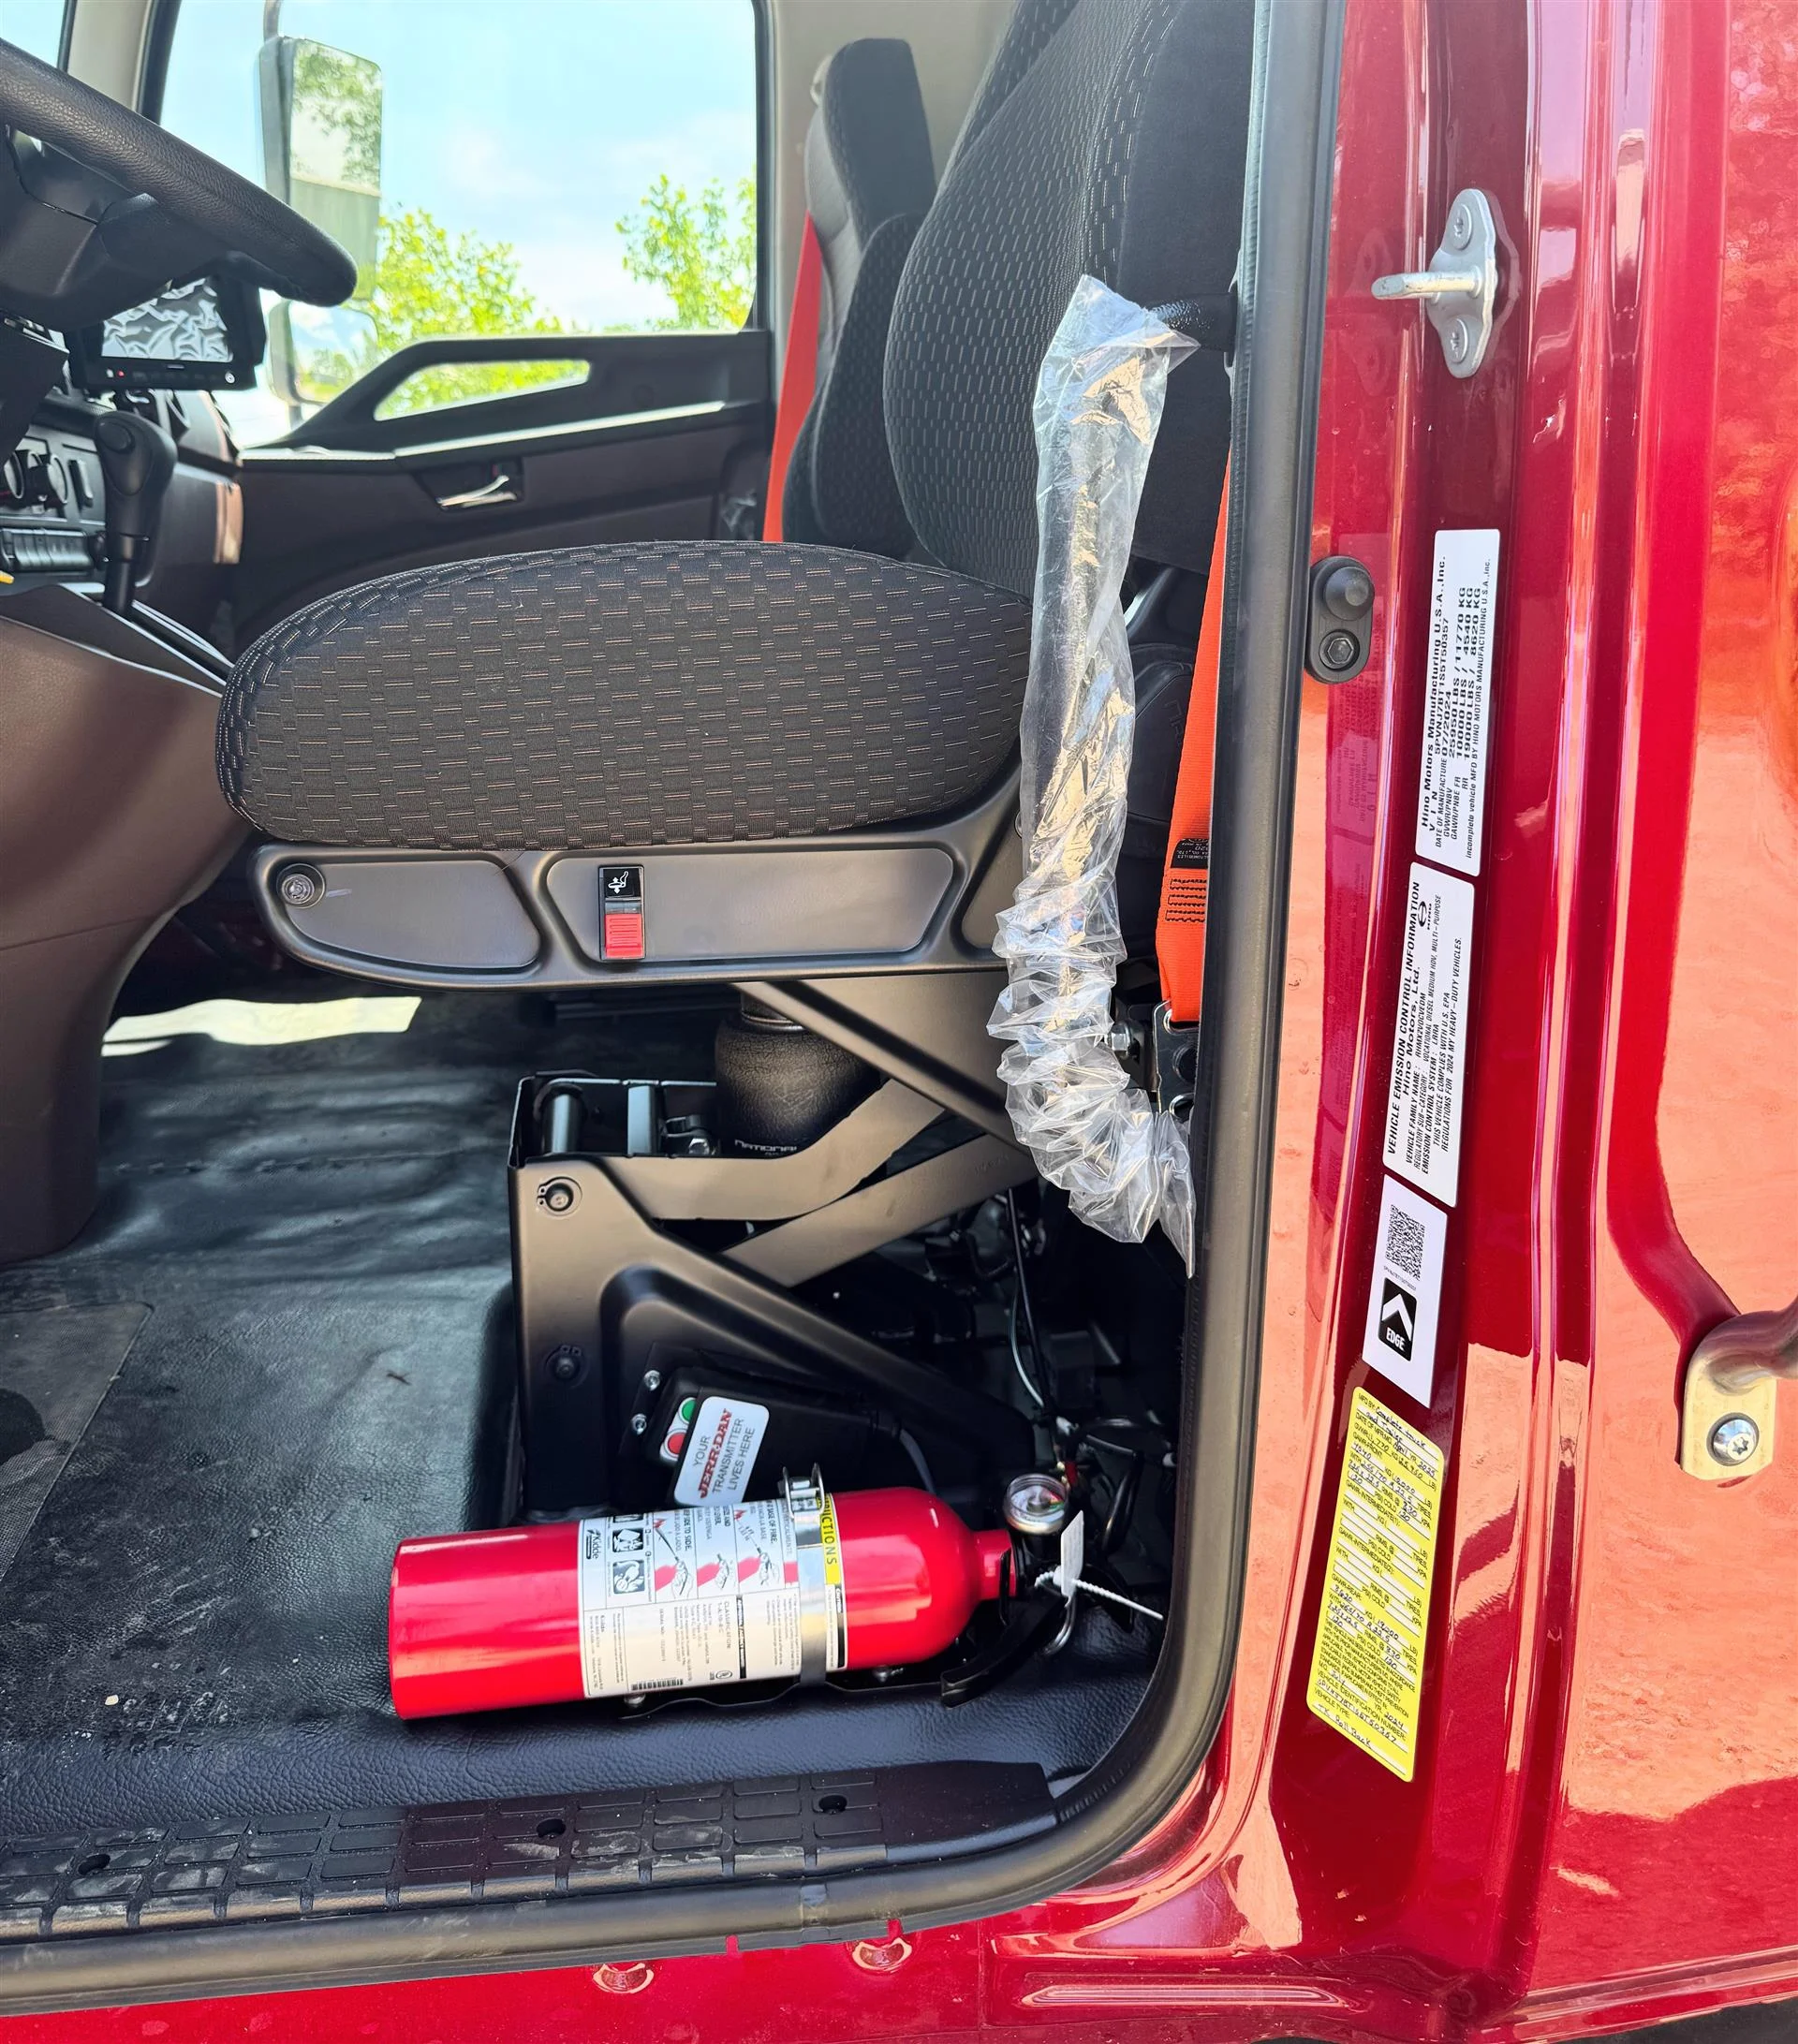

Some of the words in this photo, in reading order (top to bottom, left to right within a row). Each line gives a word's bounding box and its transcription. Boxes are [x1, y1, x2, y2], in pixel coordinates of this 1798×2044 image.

[1466, 587, 1473, 608] KG
[1472, 587, 1480, 609] KG
[1462, 613, 1471, 655] 4540
[1469, 614, 1479, 655] 8620
[1476, 607, 1487, 682] MANUFACTURING
[1426, 639, 1440, 738] Manufacturing
[1448, 708, 1457, 757] 25950
[1458, 586, 1466, 608] KG
[1473, 684, 1482, 721] MOTORS
[1441, 690, 1452, 757] 07/2024
[1455, 710, 1465, 759] 10000
[1463, 711, 1472, 760] 19000
[1422, 743, 1433, 790] Motors
[1469, 761, 1478, 781] MFD
[1471, 746, 1479, 759] BY
[1437, 757, 1447, 815] MANUFACTURE
[1453, 775, 1461, 787] FR
[1461, 776, 1468, 789] RR
[1467, 783, 1476, 812] vehicle
[1420, 795, 1430, 827] Hino
[1437, 816, 1443, 827] OF
[1403, 880, 1422, 972] INFORMATION
[1452, 935, 1462, 978] VEHICLES.
[1410, 964, 1420, 994] Ltd.
[1427, 969, 1436, 998] MEDIUM
[1398, 973, 1412, 1035] CONTROL
[1425, 998, 1434, 1022] DIESEL
[1440, 1008, 1449, 1027] U.S.
[1405, 997, 1418, 1056] Motors,
[1422, 1022, 1432, 1062] VOCATIONAL
[1439, 1028, 1448, 1051] WITH
[1447, 1037, 1454, 1052] MY
[1392, 1037, 1407, 1100] EMISSION
[1402, 1059, 1412, 1096] Hino
[1411, 1069, 1420, 1096] NAME
[1427, 1056, 1437, 1092] SYSTEM
[1436, 1051, 1446, 1093] COMPLIES
[1444, 1077, 1452, 1096] FOR
[1387, 1101, 1400, 1155] VEHICLE
[1408, 1096, 1418, 1129] FAMILY
[1424, 1092, 1434, 1132] CONTROL
[1434, 1093, 1443, 1127] VEHICLE
[1440, 1095, 1452, 1153] REGULATIONS
[1405, 1127, 1415, 1165] VEHICLE
[1412, 1125, 1423, 1170] REGULATORY
[1421, 1132, 1431, 1175] EMISSION
[1432, 1126, 1441, 1147] THIS
[1385, 1326, 1406, 1351] EDGE
[692, 1434, 711, 1466] YOUR
[711, 1417, 744, 1493] TRANSMITTER
[726, 1459, 744, 1490] LIVES
[736, 1426, 756, 1458] HERE
[591, 1535, 601, 1559] Kidde
[1314, 1687, 1334, 1707] VEHICLE
[1317, 1668, 1338, 1689] VEHICLE
[1339, 1685, 1379, 1722] IDENTIFICATION
